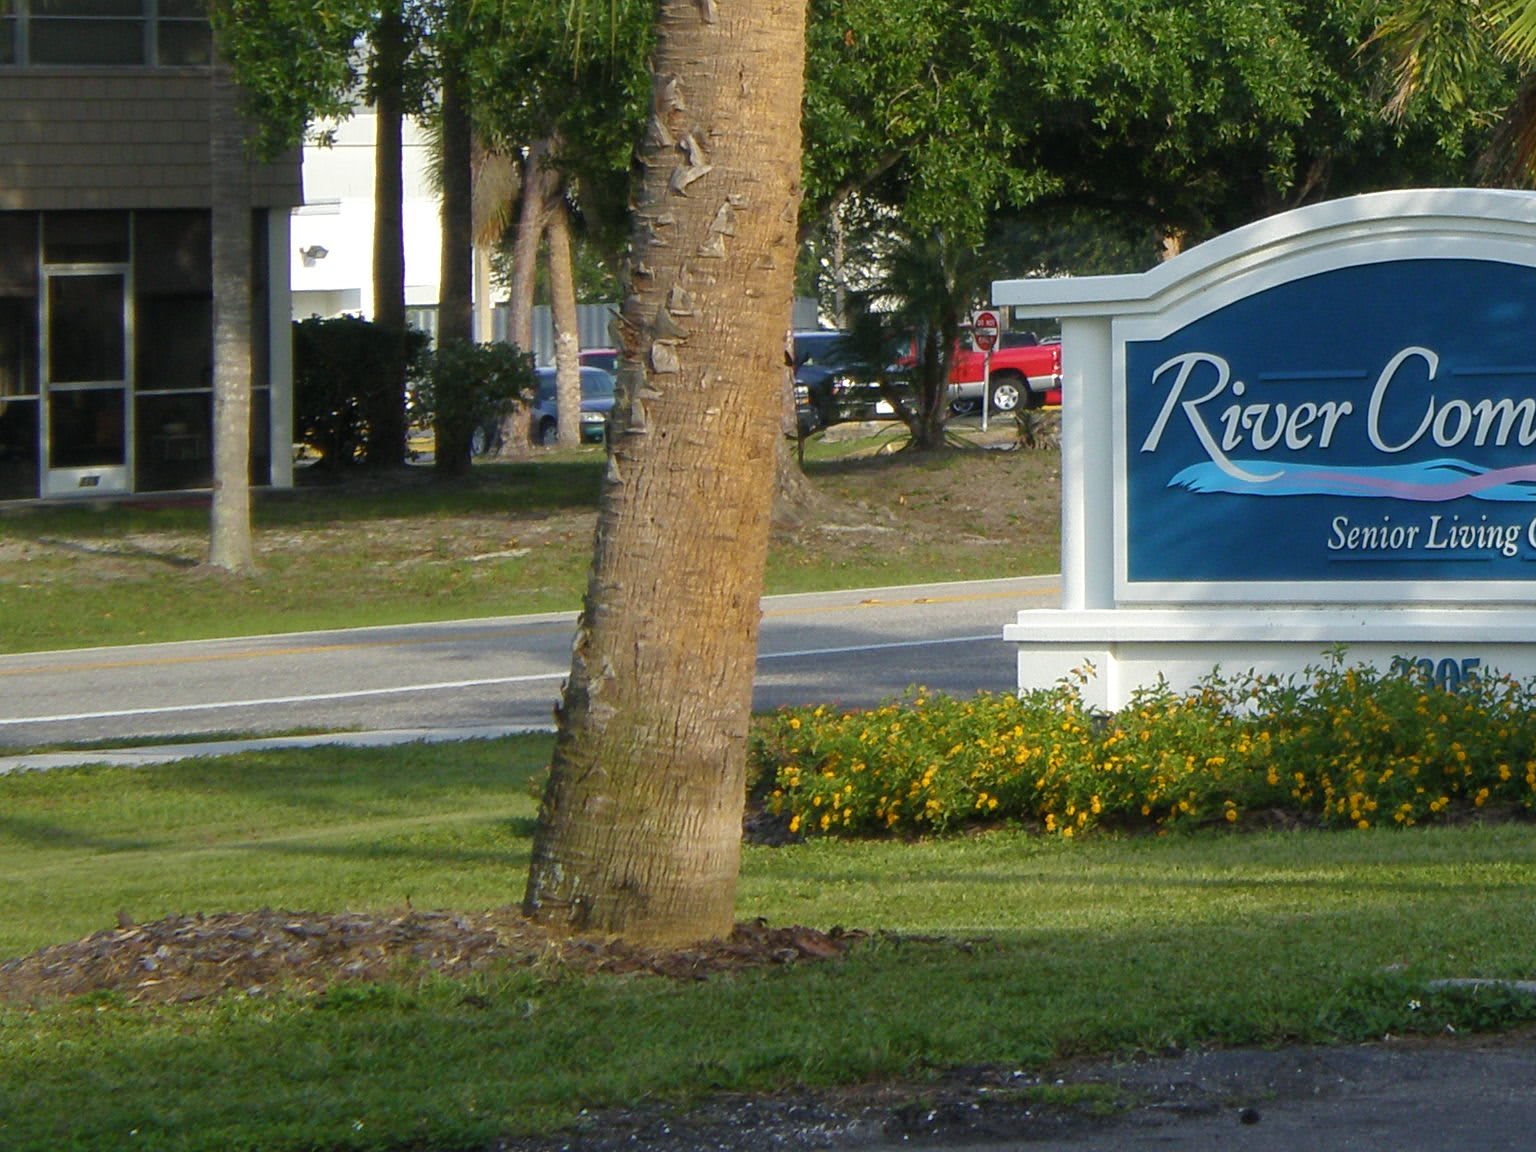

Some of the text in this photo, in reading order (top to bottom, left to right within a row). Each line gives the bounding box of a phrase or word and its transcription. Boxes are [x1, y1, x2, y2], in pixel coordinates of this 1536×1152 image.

[1140, 351, 1353, 483] River
[1327, 515, 1420, 550] Senior
[1424, 514, 1522, 557] Living
